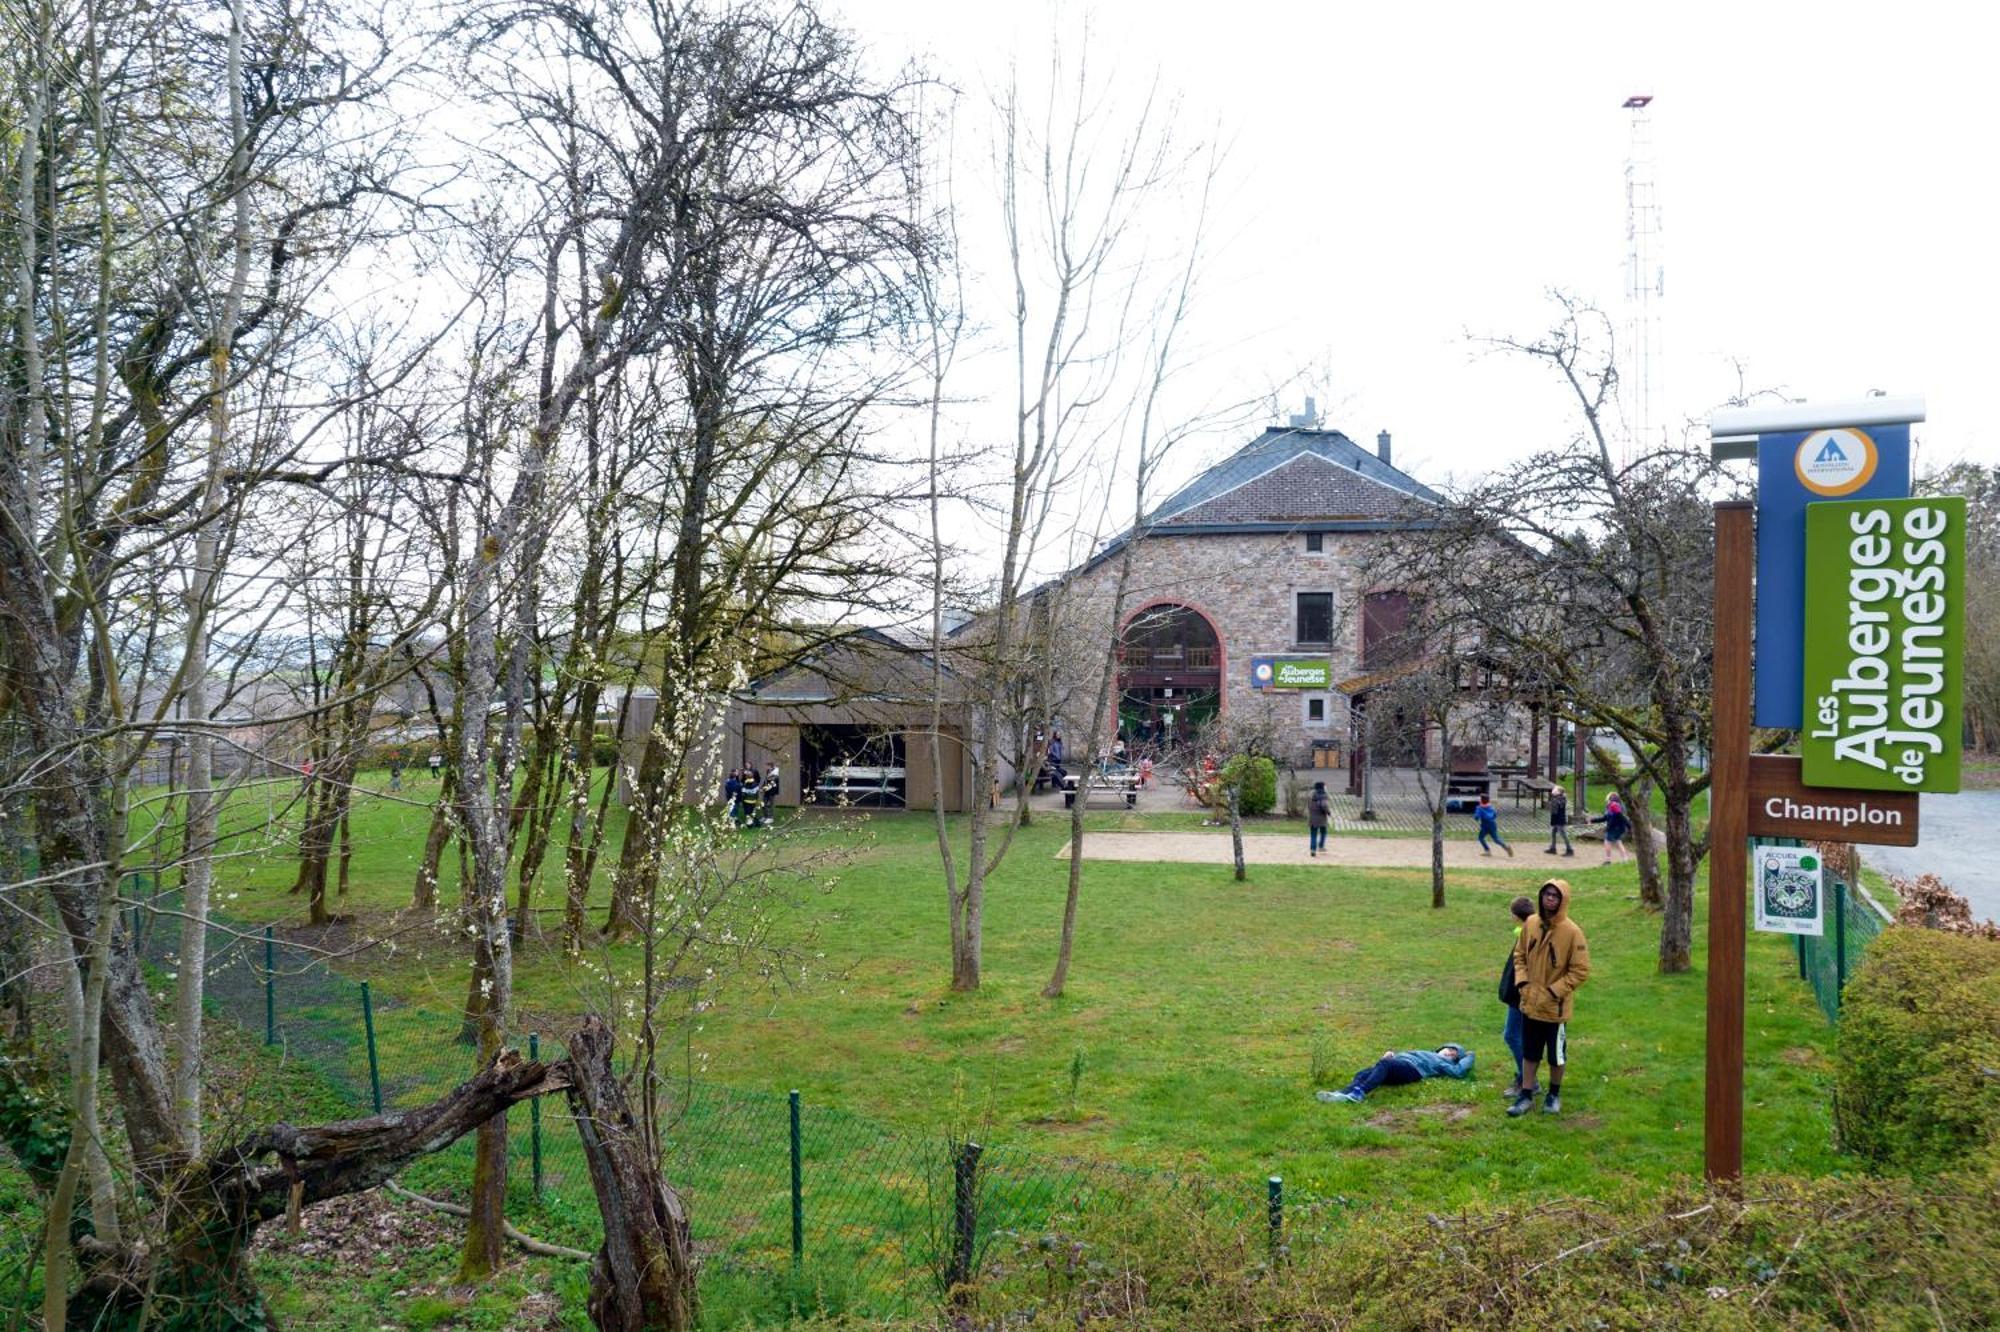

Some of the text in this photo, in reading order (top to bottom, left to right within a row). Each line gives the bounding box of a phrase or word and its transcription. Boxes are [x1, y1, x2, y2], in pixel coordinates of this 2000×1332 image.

[1832, 508, 1907, 770] Auberges
[1885, 507, 1947, 785] de Jeunesse
[1283, 675, 1325, 683] Jeunesse
[1812, 696, 1839, 738] Les
[1765, 798, 1902, 826] Champlon
